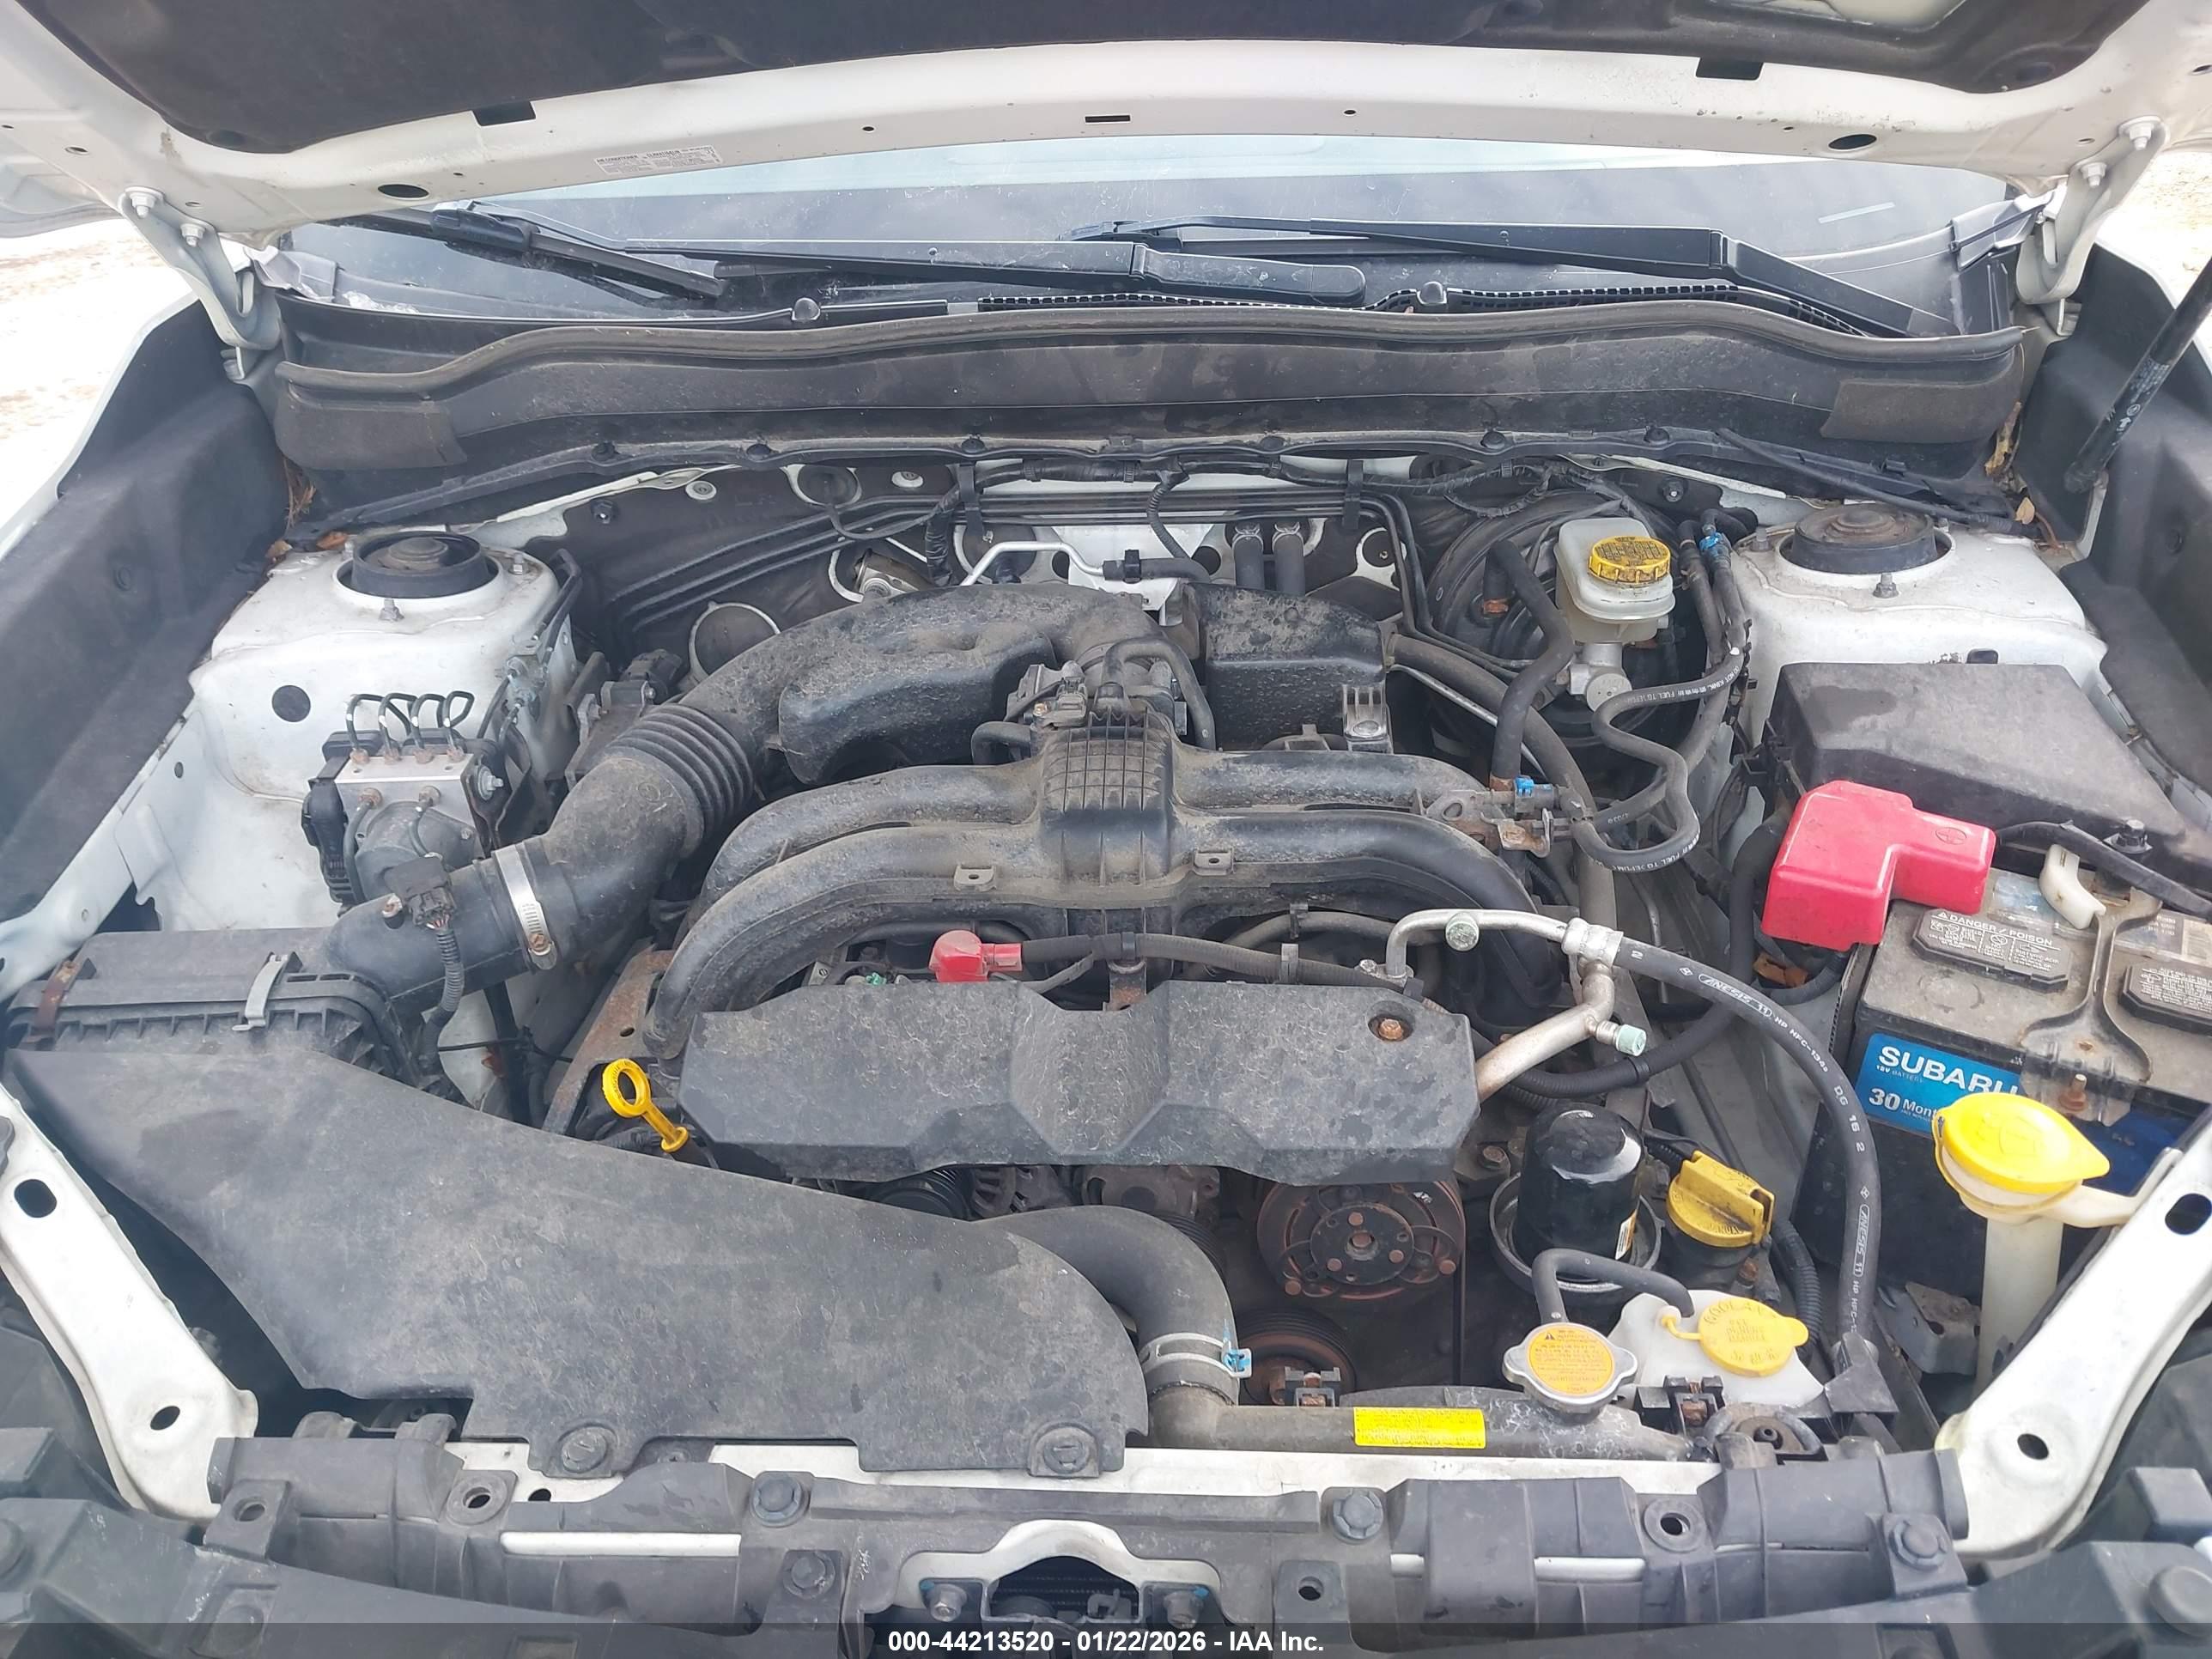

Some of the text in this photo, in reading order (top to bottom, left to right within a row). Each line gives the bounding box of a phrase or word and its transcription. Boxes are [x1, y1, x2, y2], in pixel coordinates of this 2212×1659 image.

[1949, 914, 1996, 933] DANGER
[2009, 929, 2052, 946] POISON
[1869, 1088, 1900, 1111] 30
[1902, 1098, 1938, 1116] Mont
[1833, 1085, 1849, 1106] DG
[1849, 1115, 1861, 1133] 16
[1856, 1141, 1865, 1152] 2
